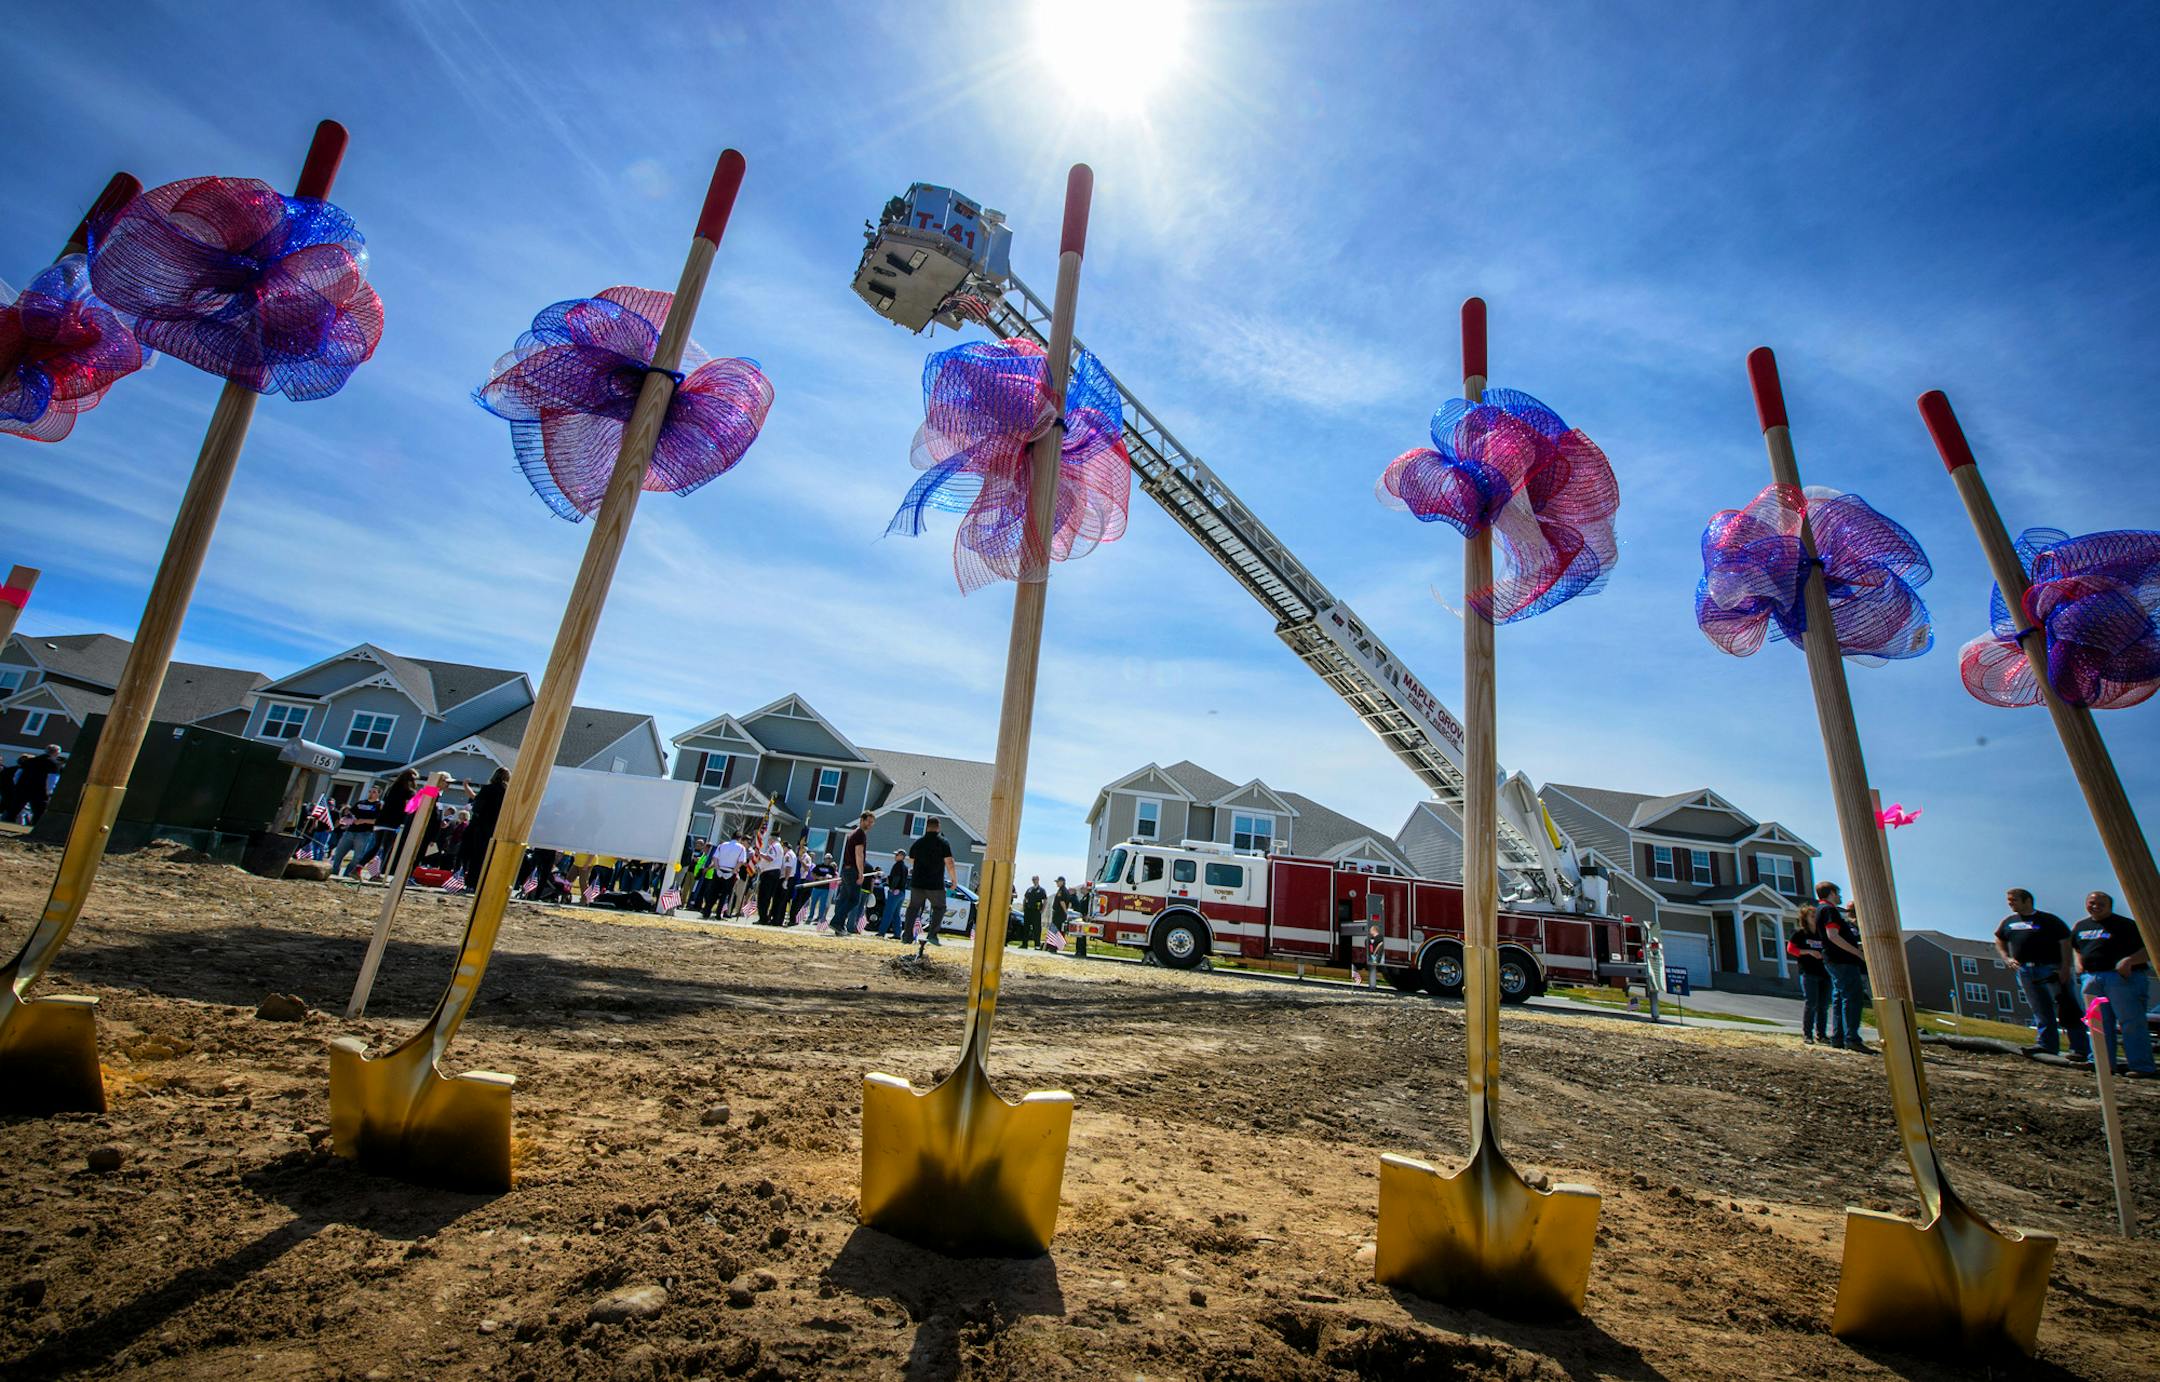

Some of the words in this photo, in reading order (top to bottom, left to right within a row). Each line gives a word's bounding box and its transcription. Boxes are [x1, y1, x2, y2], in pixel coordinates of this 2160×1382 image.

[917, 211, 975, 249] T-41
[1403, 673, 1436, 712] MAPLE
[1408, 692, 1423, 711] FIRE
[1432, 717, 1459, 747] RESCUE
